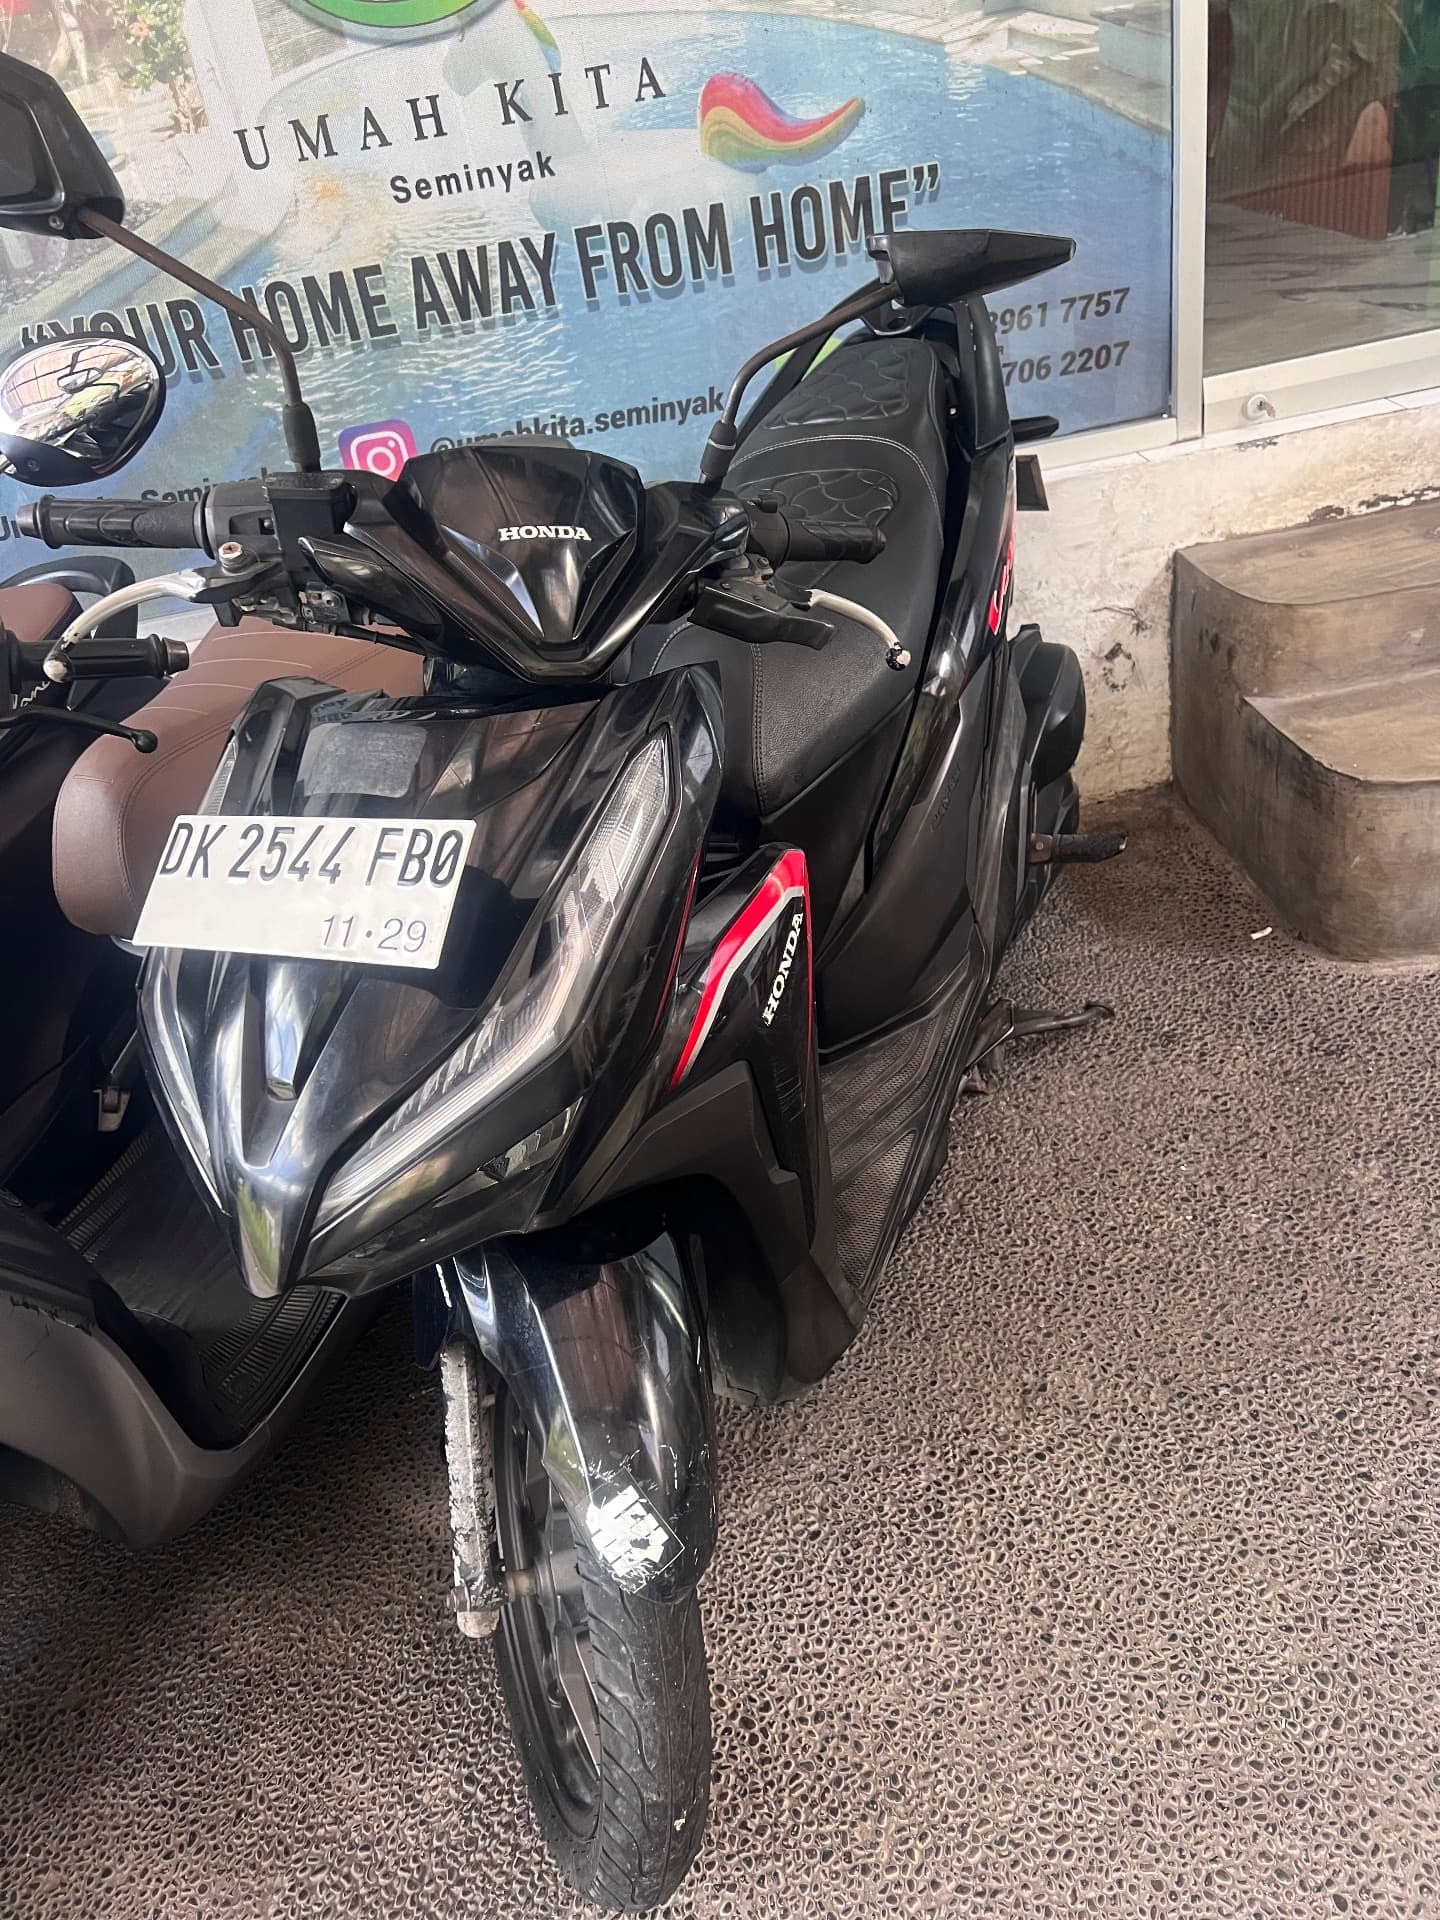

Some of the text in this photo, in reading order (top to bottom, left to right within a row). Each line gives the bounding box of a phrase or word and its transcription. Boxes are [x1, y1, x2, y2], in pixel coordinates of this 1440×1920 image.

[233, 56, 666, 171] UMAH KITA
[390, 151, 557, 204] Seminyak
[226, 264, 398, 361] HOME
[411, 232, 556, 329] AWAY
[574, 203, 733, 299] FROM
[1060, 287, 1130, 323] 7757
[1059, 340, 1130, 376] 2207
[497, 525, 592, 541] HONDA
[159, 822, 228, 879] DK
[228, 824, 355, 885] 2544
[762, 912, 803, 1026] HONDA
